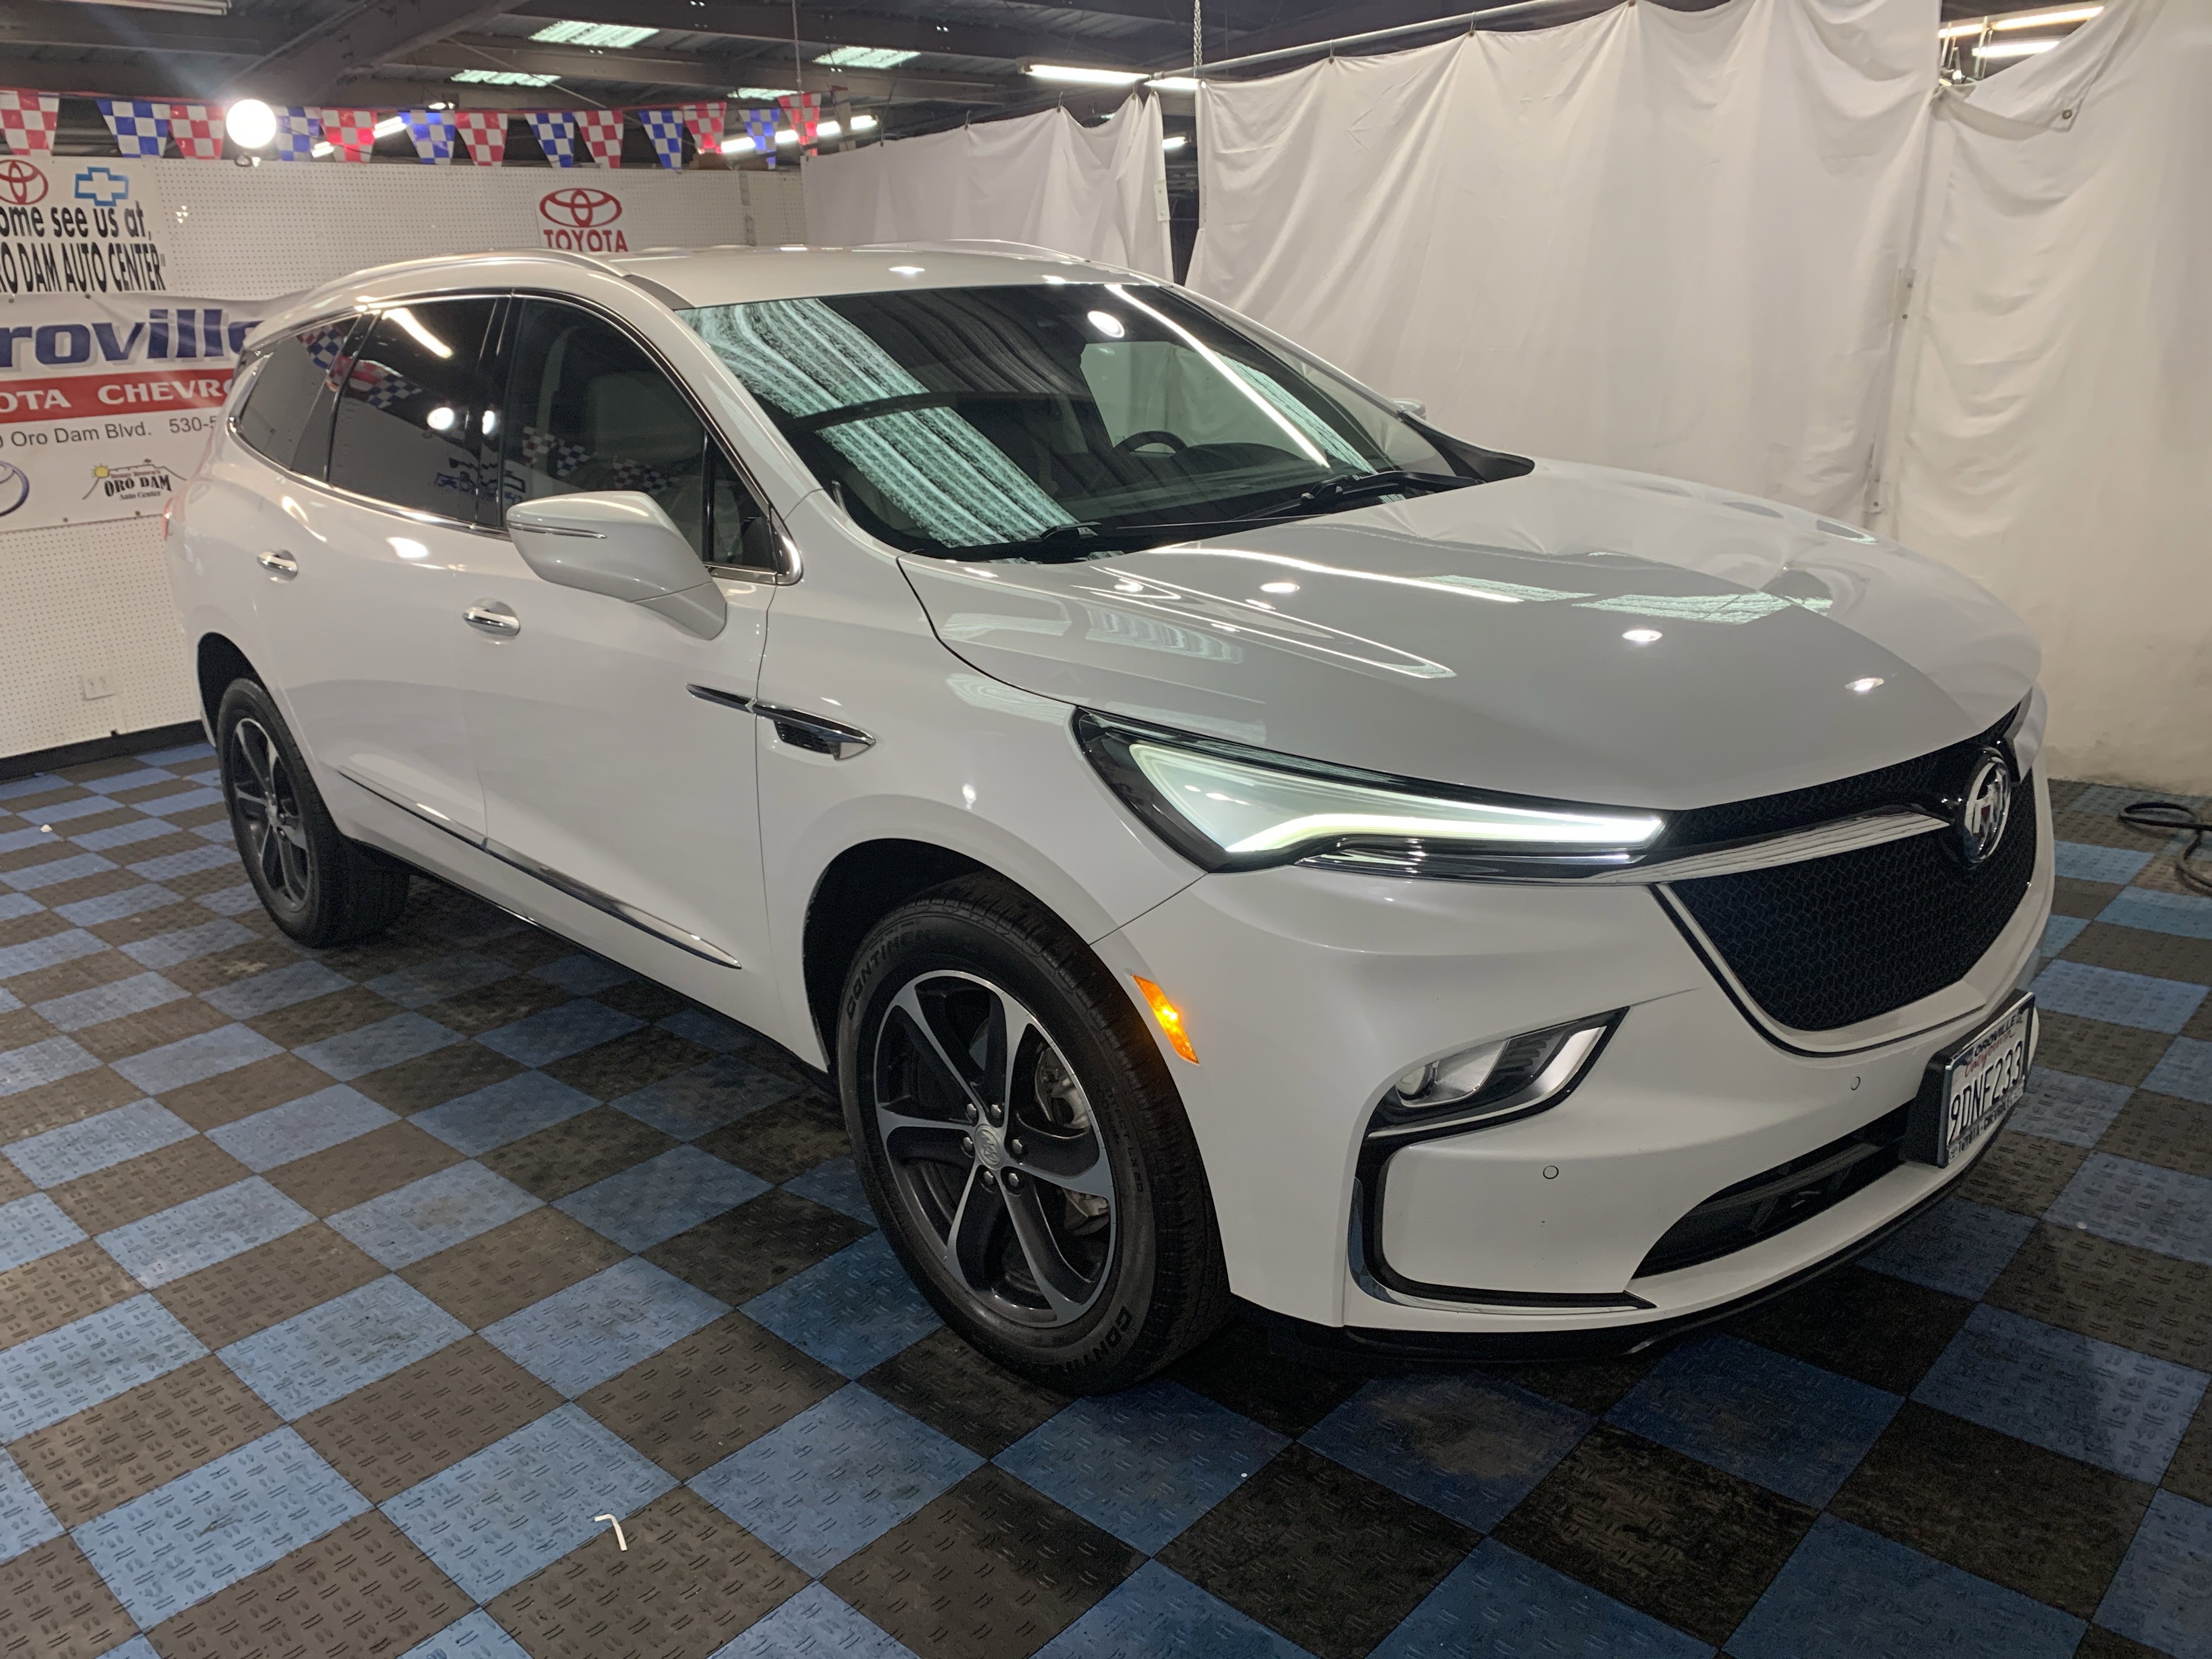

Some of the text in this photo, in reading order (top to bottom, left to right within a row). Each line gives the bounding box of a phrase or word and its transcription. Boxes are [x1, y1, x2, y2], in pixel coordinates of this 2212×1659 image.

[51, 206, 88, 237] see
[93, 207, 119, 237] us
[543, 229, 629, 252] TOYOTA
[18, 242, 61, 292] DAM
[61, 241, 106, 292] AUTO
[11, 431, 48, 447] Oro
[55, 427, 99, 444] Dam
[105, 421, 151, 439] Blvd.
[104, 475, 172, 496] ORO DAM
[1947, 1040, 2023, 1147] 9DNF233
